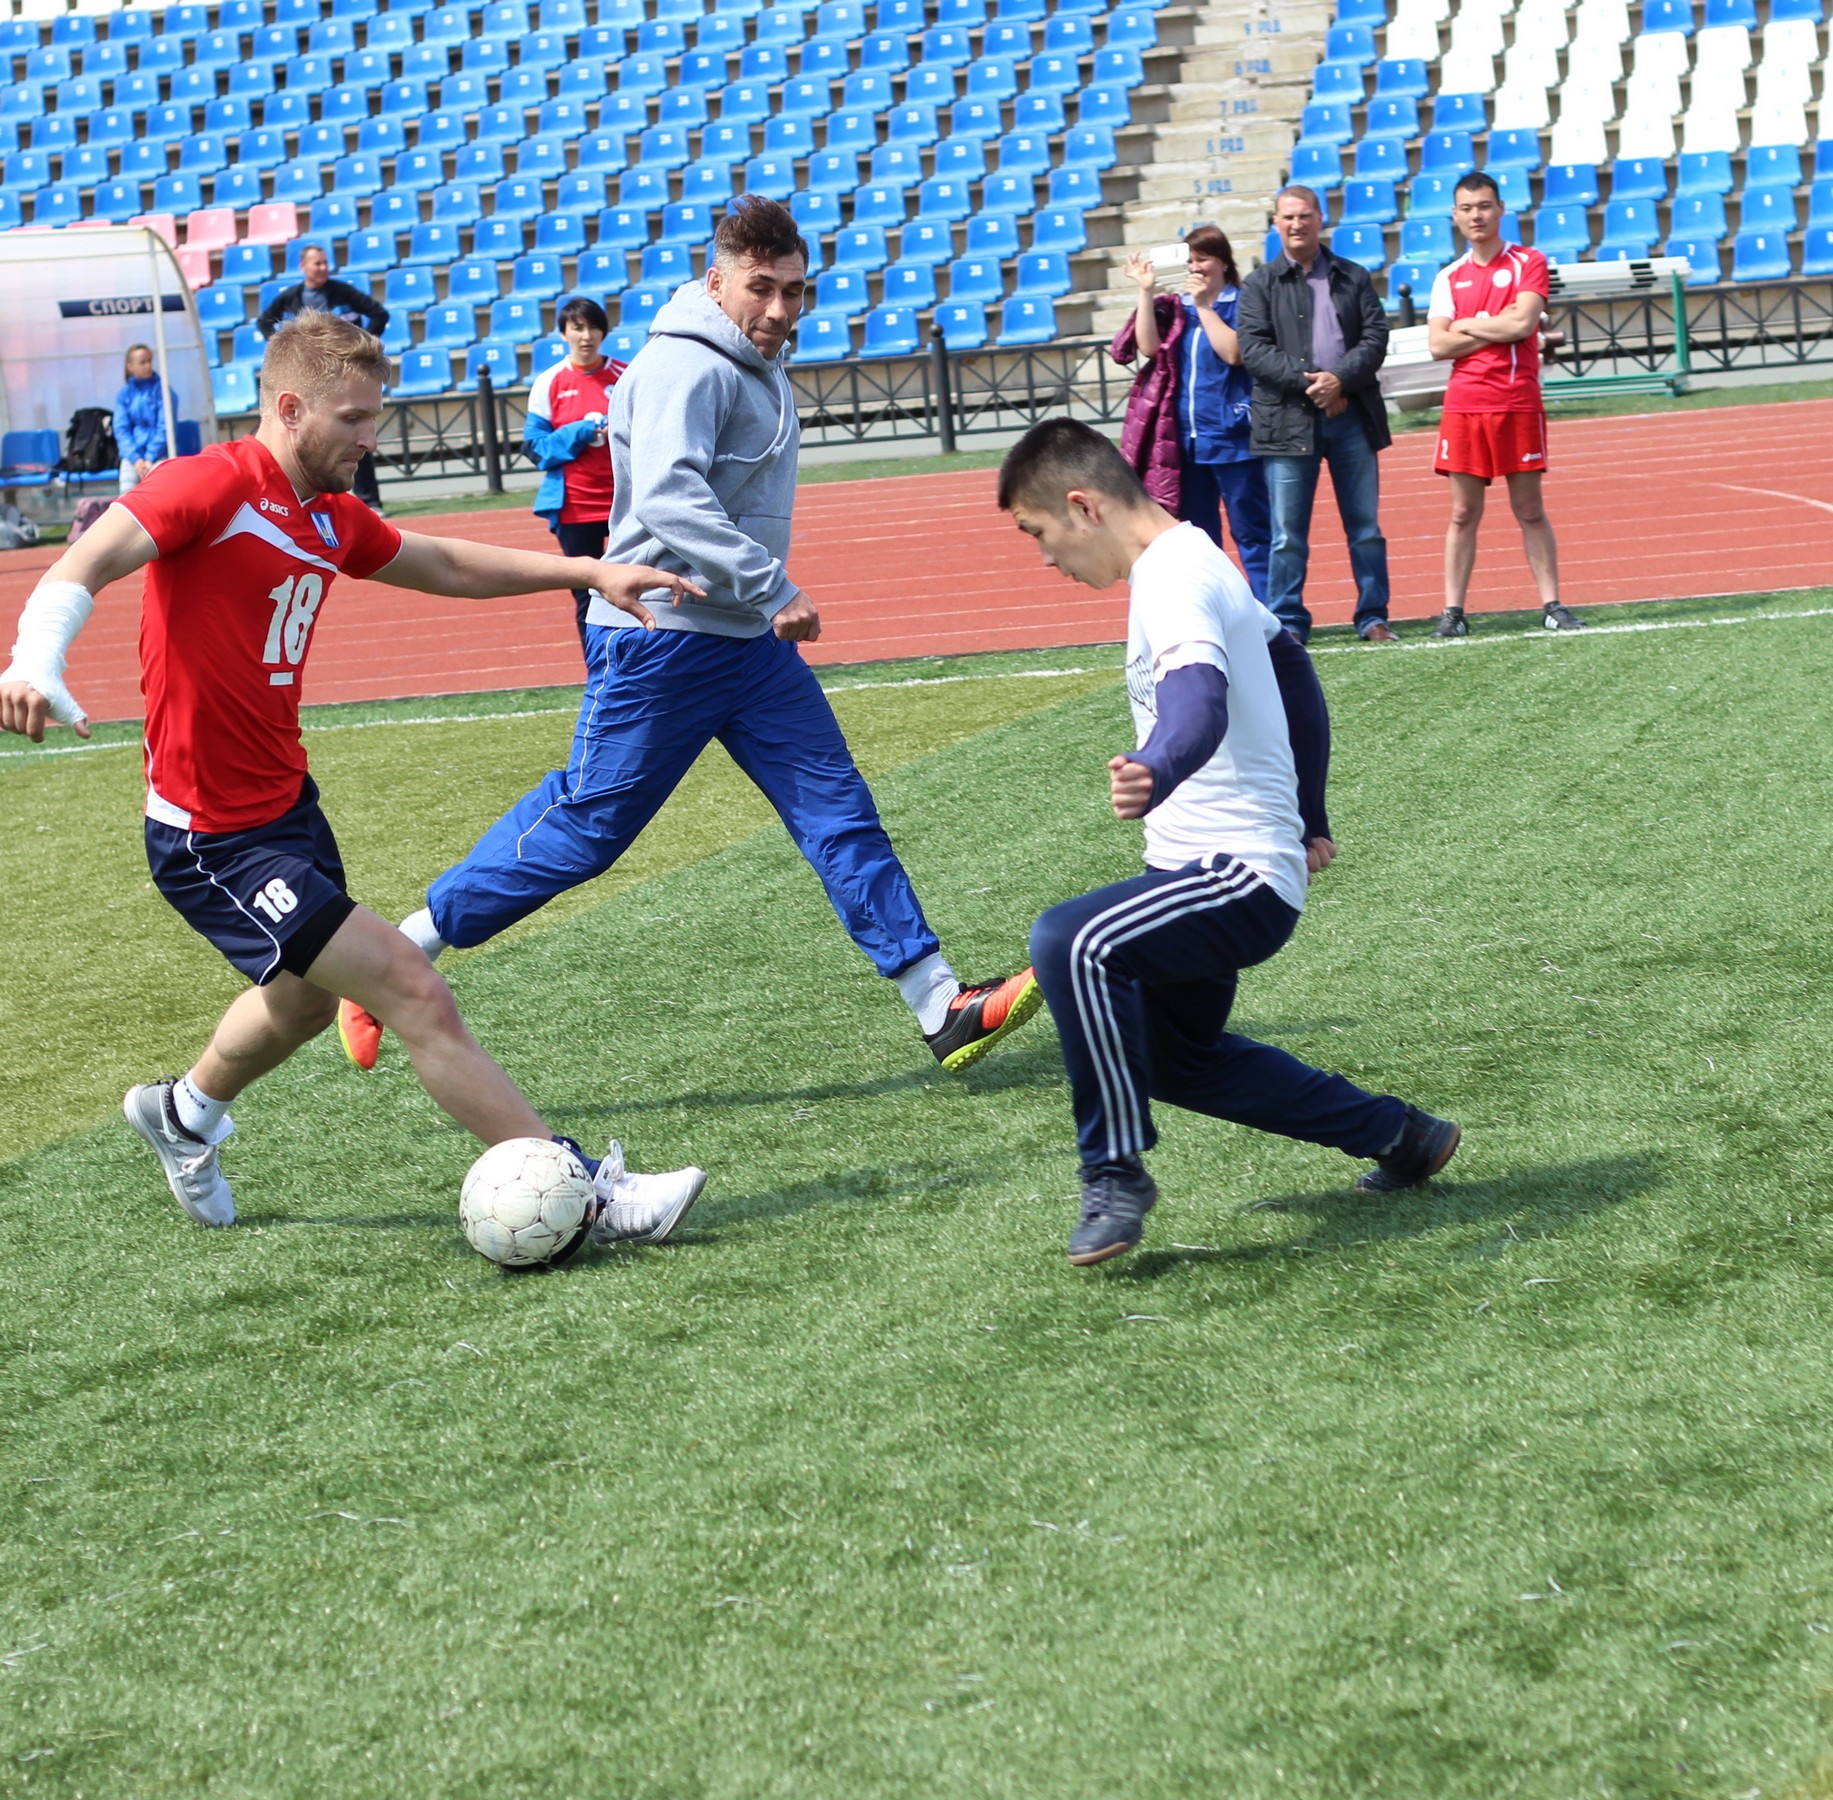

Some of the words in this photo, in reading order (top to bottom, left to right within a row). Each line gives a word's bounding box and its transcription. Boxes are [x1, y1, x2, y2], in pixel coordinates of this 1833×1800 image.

[1346, 32, 1353, 42] 1
[1335, 69, 1341, 79] 1
[1398, 63, 1406, 74] 2
[1456, 98, 1463, 108] 3
[1324, 110, 1329, 120] 1
[1389, 104, 1396, 115] 2
[1444, 137, 1451, 148] 3
[1312, 150, 1318, 161] 1
[1378, 145, 1385, 156] 2
[1434, 180, 1441, 191] 3
[1366, 186, 1374, 197] 2
[1424, 226, 1431, 236] 3
[1354, 232, 1361, 243] 2
[1412, 268, 1419, 280] 3
[88, 298, 153, 315] СПОРТ
[269, 502, 289, 517] asics
[262, 573, 323, 665] 18
[253, 878, 298, 924] 18
